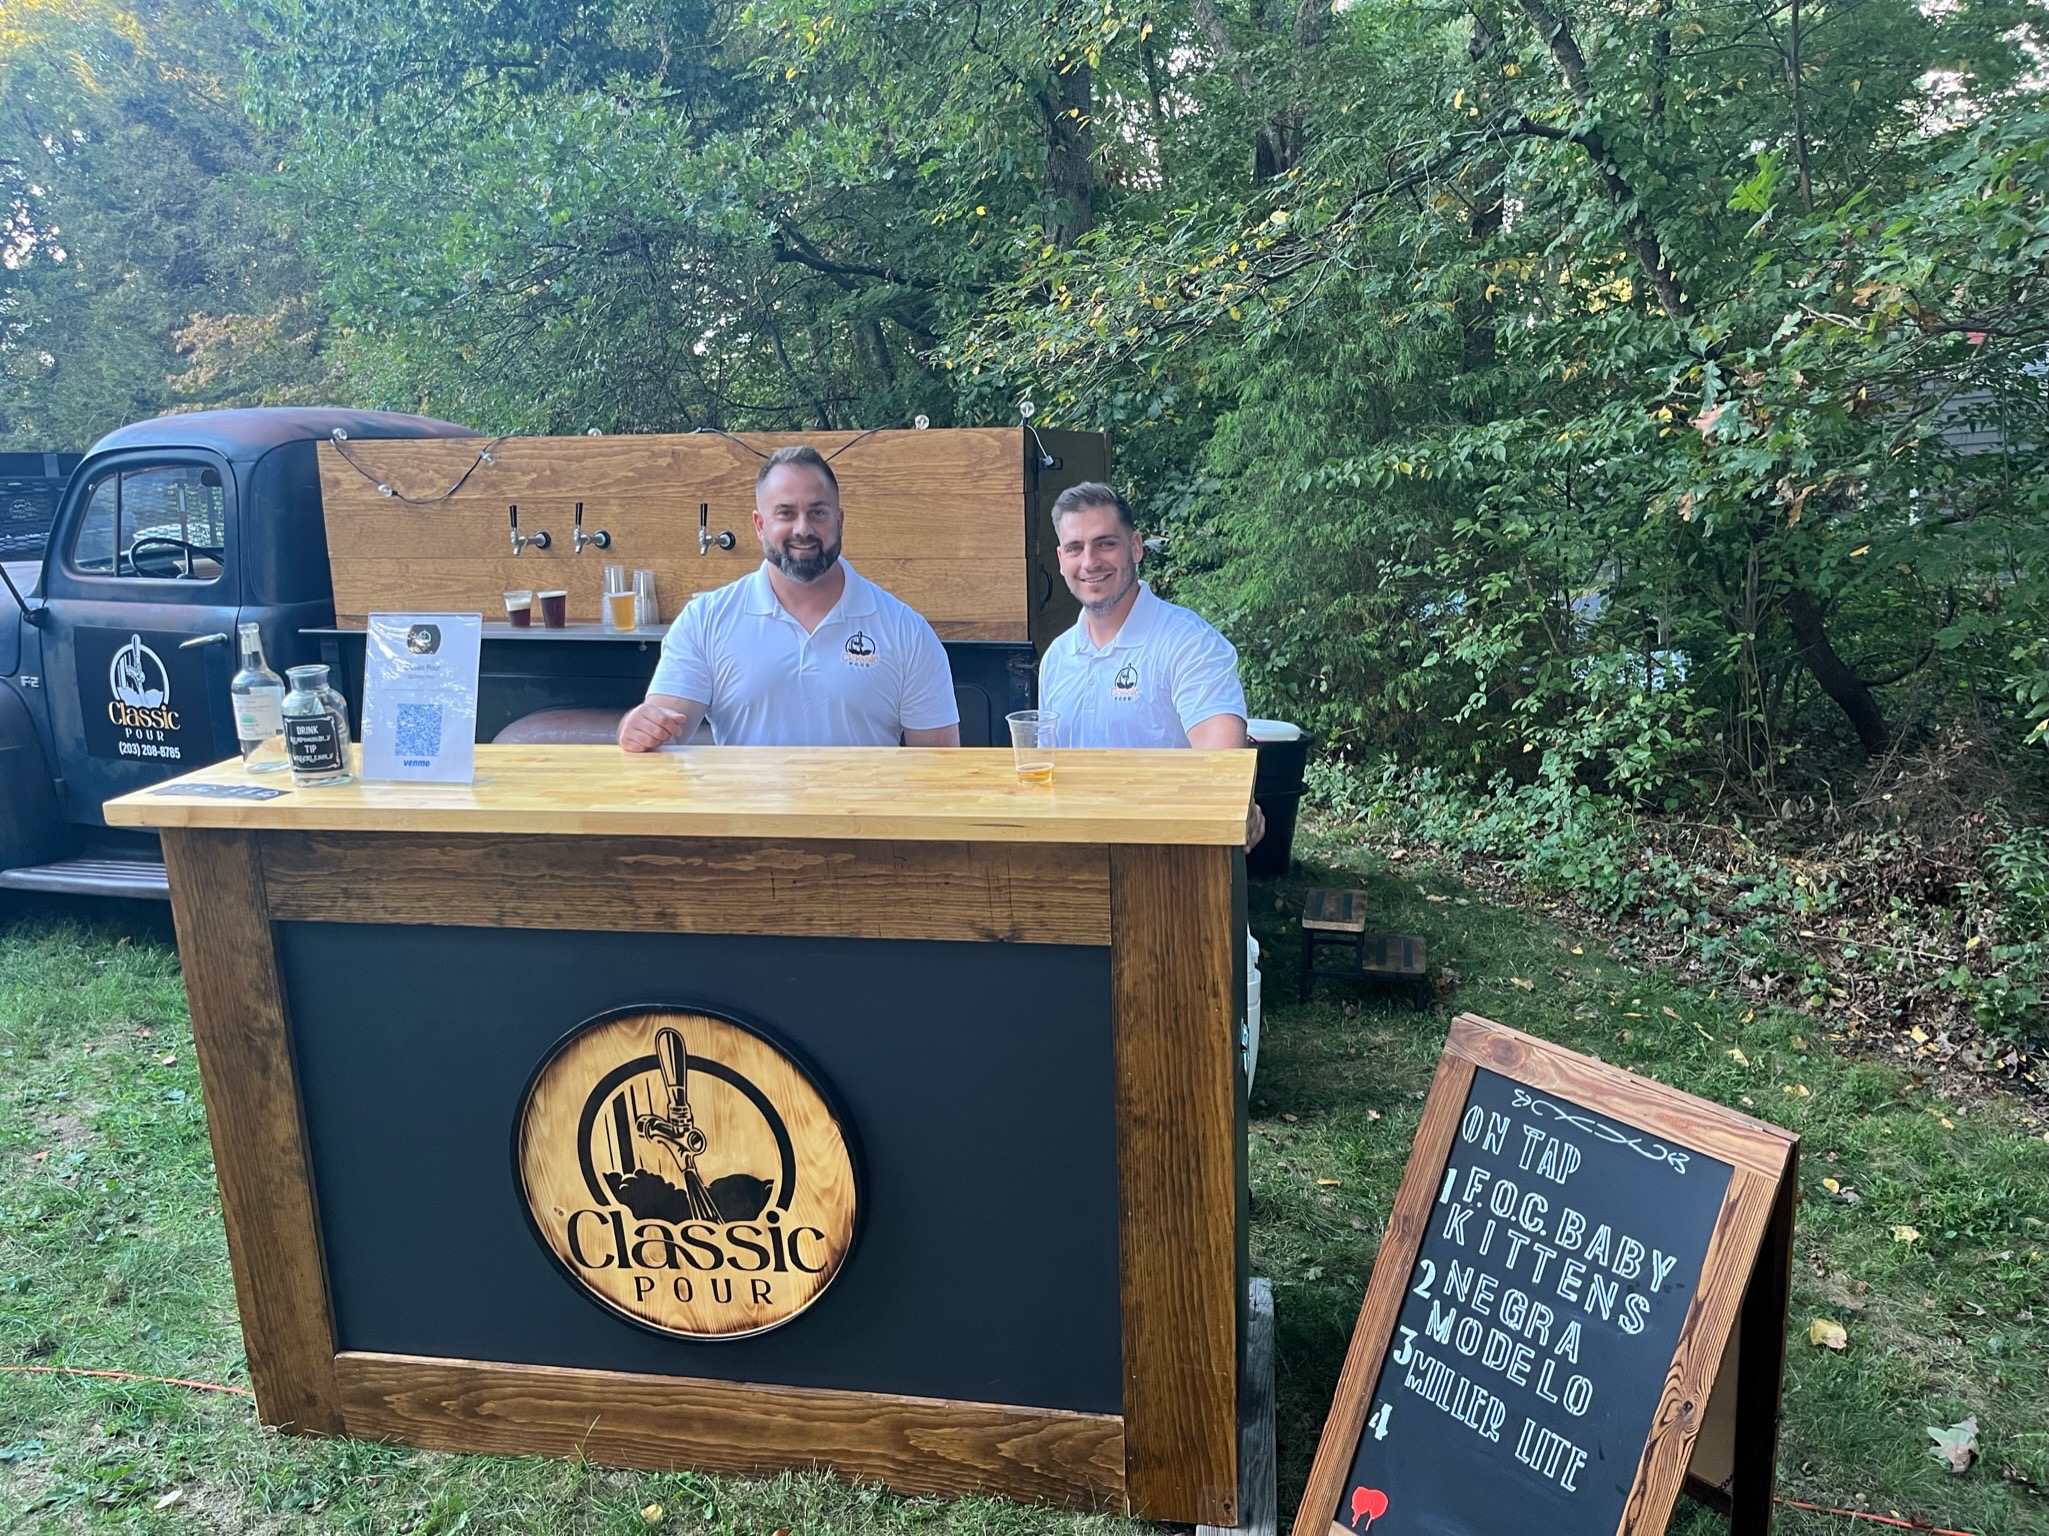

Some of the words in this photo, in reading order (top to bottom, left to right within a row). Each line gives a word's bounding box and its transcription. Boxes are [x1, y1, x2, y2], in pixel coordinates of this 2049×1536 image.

[108, 700, 181, 730] Classic
[125, 727, 165, 742] POUR
[296, 725, 319, 735] DRINK
[119, 741, 141, 757] (203)
[141, 744, 181, 759] 208-8785
[304, 744, 317, 754] TIP
[1462, 1104, 1511, 1155] ON
[1518, 1123, 1582, 1185] TAP
[567, 1209, 828, 1273] Classic
[1439, 1167, 1458, 1204] 1
[1554, 1207, 1678, 1293] BABY
[633, 1275, 774, 1305] POUR
[1442, 1202, 1651, 1335] KITTENS
[1413, 1258, 1436, 1299] 2
[1443, 1259, 1582, 1364] NEGRA
[1392, 1325, 1419, 1365] 3
[1425, 1299, 1594, 1417] MODELO
[1368, 1403, 1393, 1441] 4
[1404, 1349, 1506, 1443] MILLER
[1514, 1417, 1588, 1492] LITE
